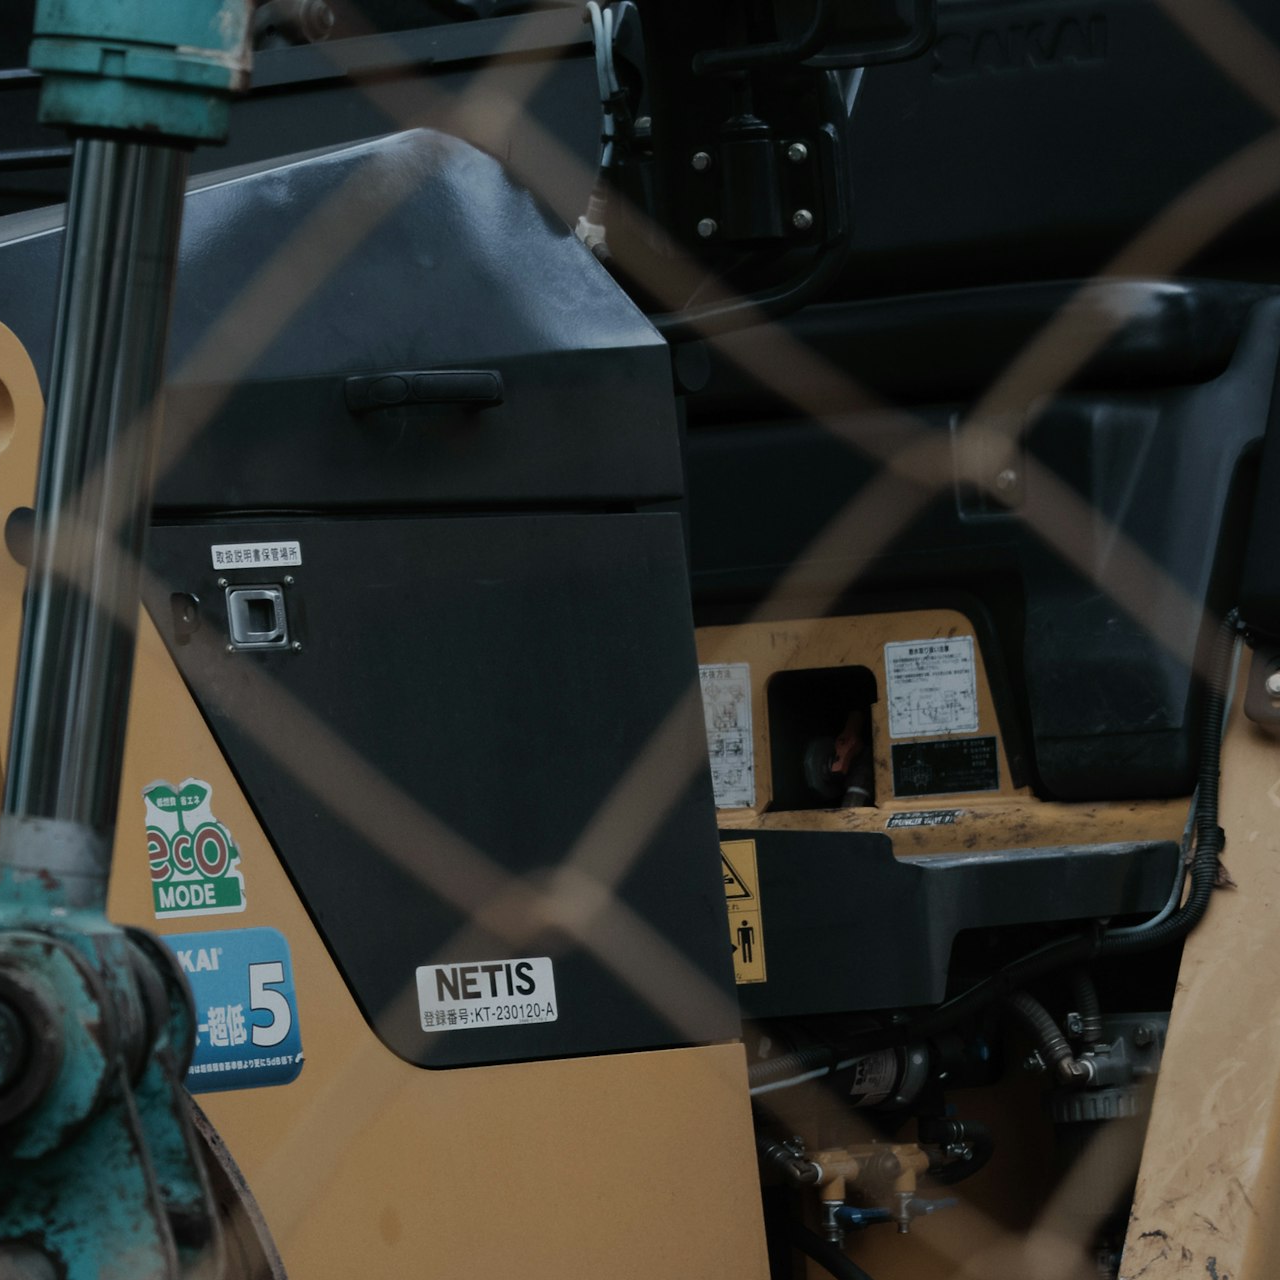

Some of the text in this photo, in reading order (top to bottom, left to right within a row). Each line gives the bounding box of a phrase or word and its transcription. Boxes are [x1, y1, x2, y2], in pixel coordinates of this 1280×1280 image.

[147, 828, 228, 881] eco
[158, 883, 217, 908] MODE
[177, 947, 219, 972] KAI
[435, 962, 536, 1002] NETIS
